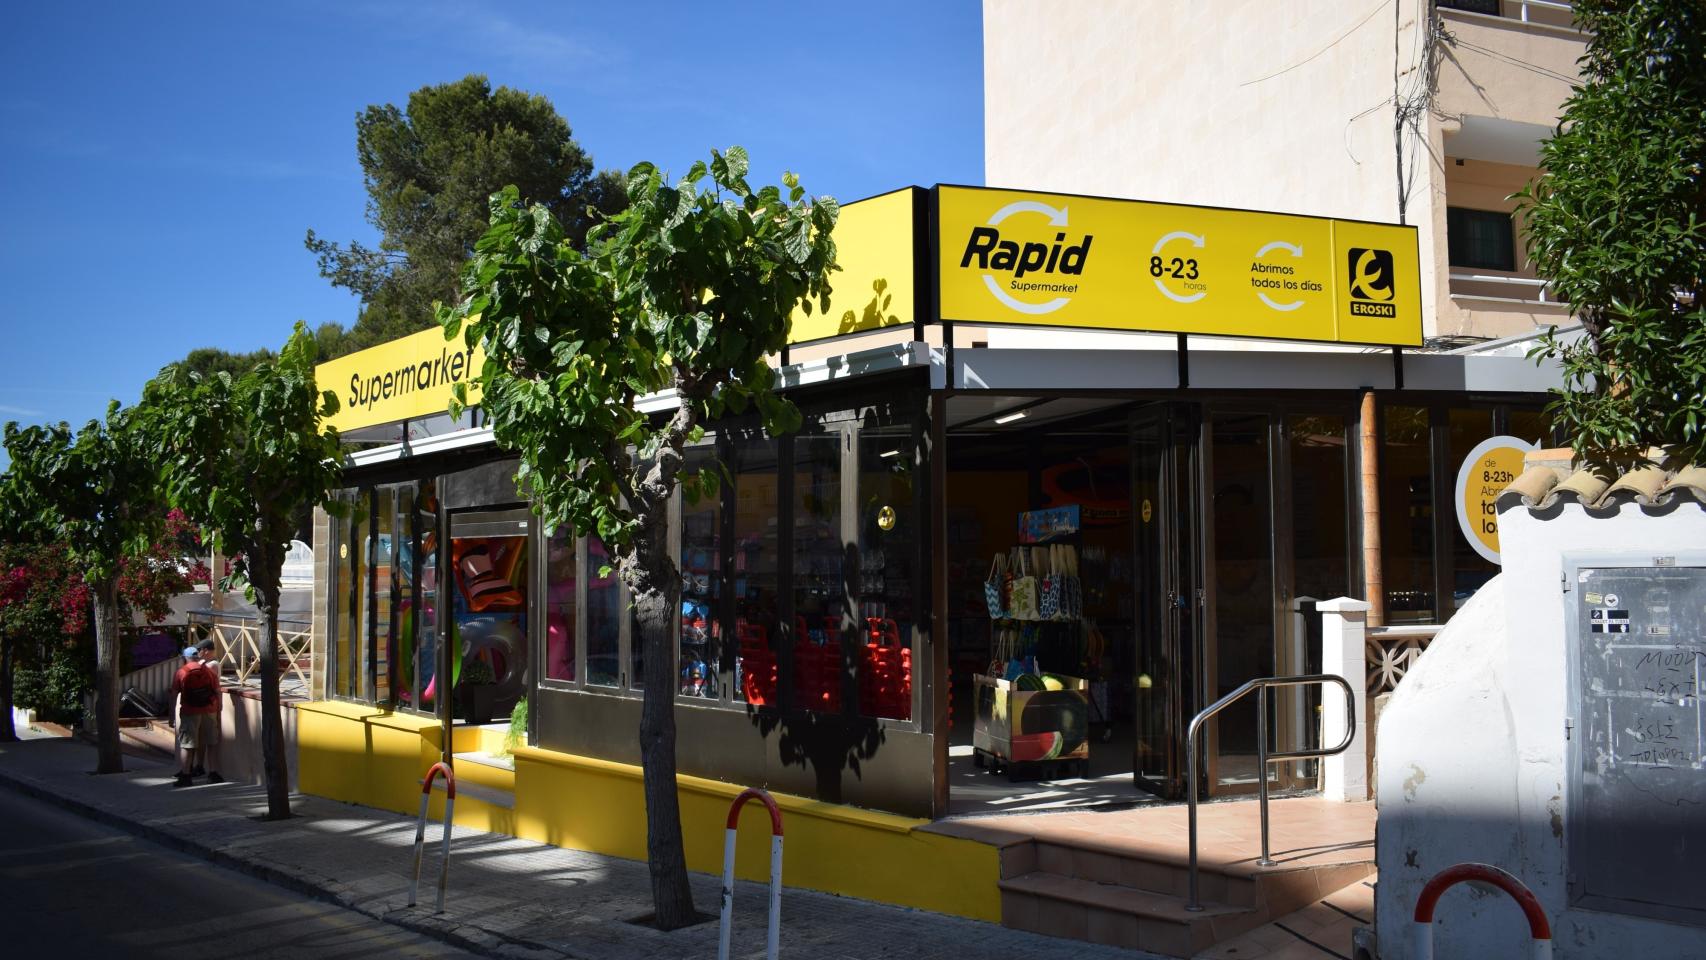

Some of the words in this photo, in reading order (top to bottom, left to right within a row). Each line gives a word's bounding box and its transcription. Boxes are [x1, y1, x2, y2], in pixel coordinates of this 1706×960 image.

[960, 226, 1093, 278] Rapid
[1150, 256, 1199, 280] 8-23
[1251, 262, 1294, 275] Abrimos
[1010, 280, 1079, 294] Supermarket
[1183, 281, 1207, 292] horas
[1251, 277, 1281, 290] todos
[1283, 279, 1298, 291] los
[1300, 280, 1323, 292] días
[1353, 304, 1394, 316] EROSKI
[348, 347, 475, 411] Supermarket
[1484, 458, 1497, 468] de
[1483, 470, 1514, 483] 8-23h
[1482, 518, 1498, 534] lo
